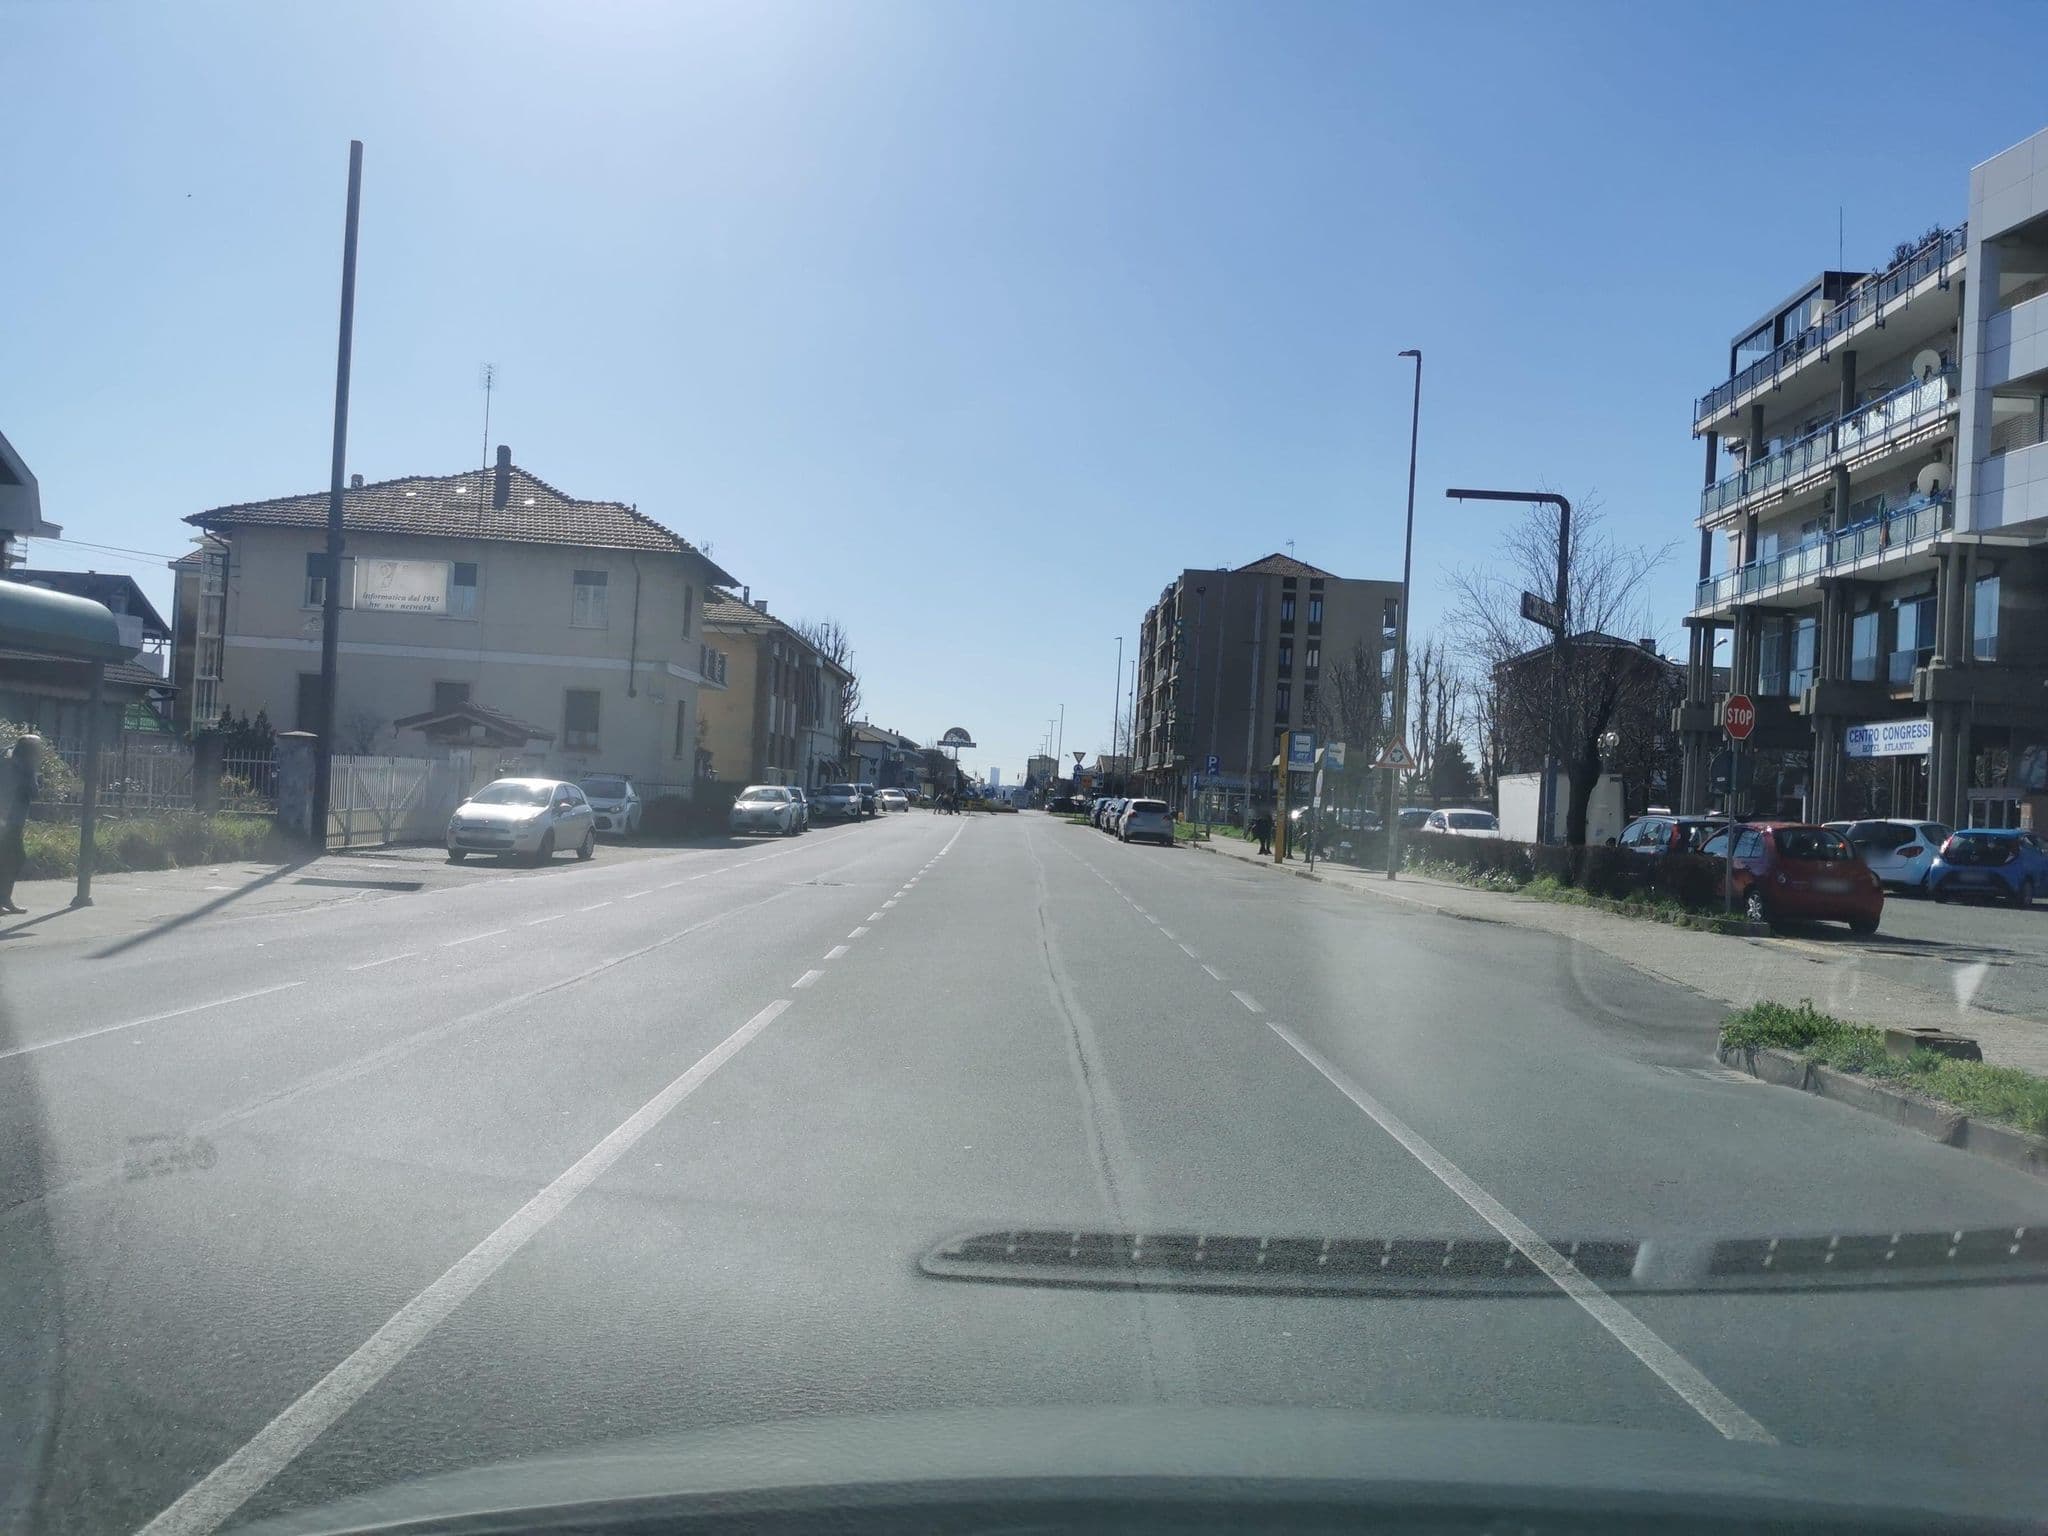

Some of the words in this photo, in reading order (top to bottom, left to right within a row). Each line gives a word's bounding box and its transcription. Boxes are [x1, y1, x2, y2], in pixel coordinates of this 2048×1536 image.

[1727, 708, 1752, 725] STOP
[1849, 727, 1879, 743] CENTRO
[1883, 723, 1931, 741] CONGRESSI
[1862, 743, 1880, 753] HOTEL
[1884, 742, 1914, 752] ATLANTIC
[1208, 756, 1217, 767] P
